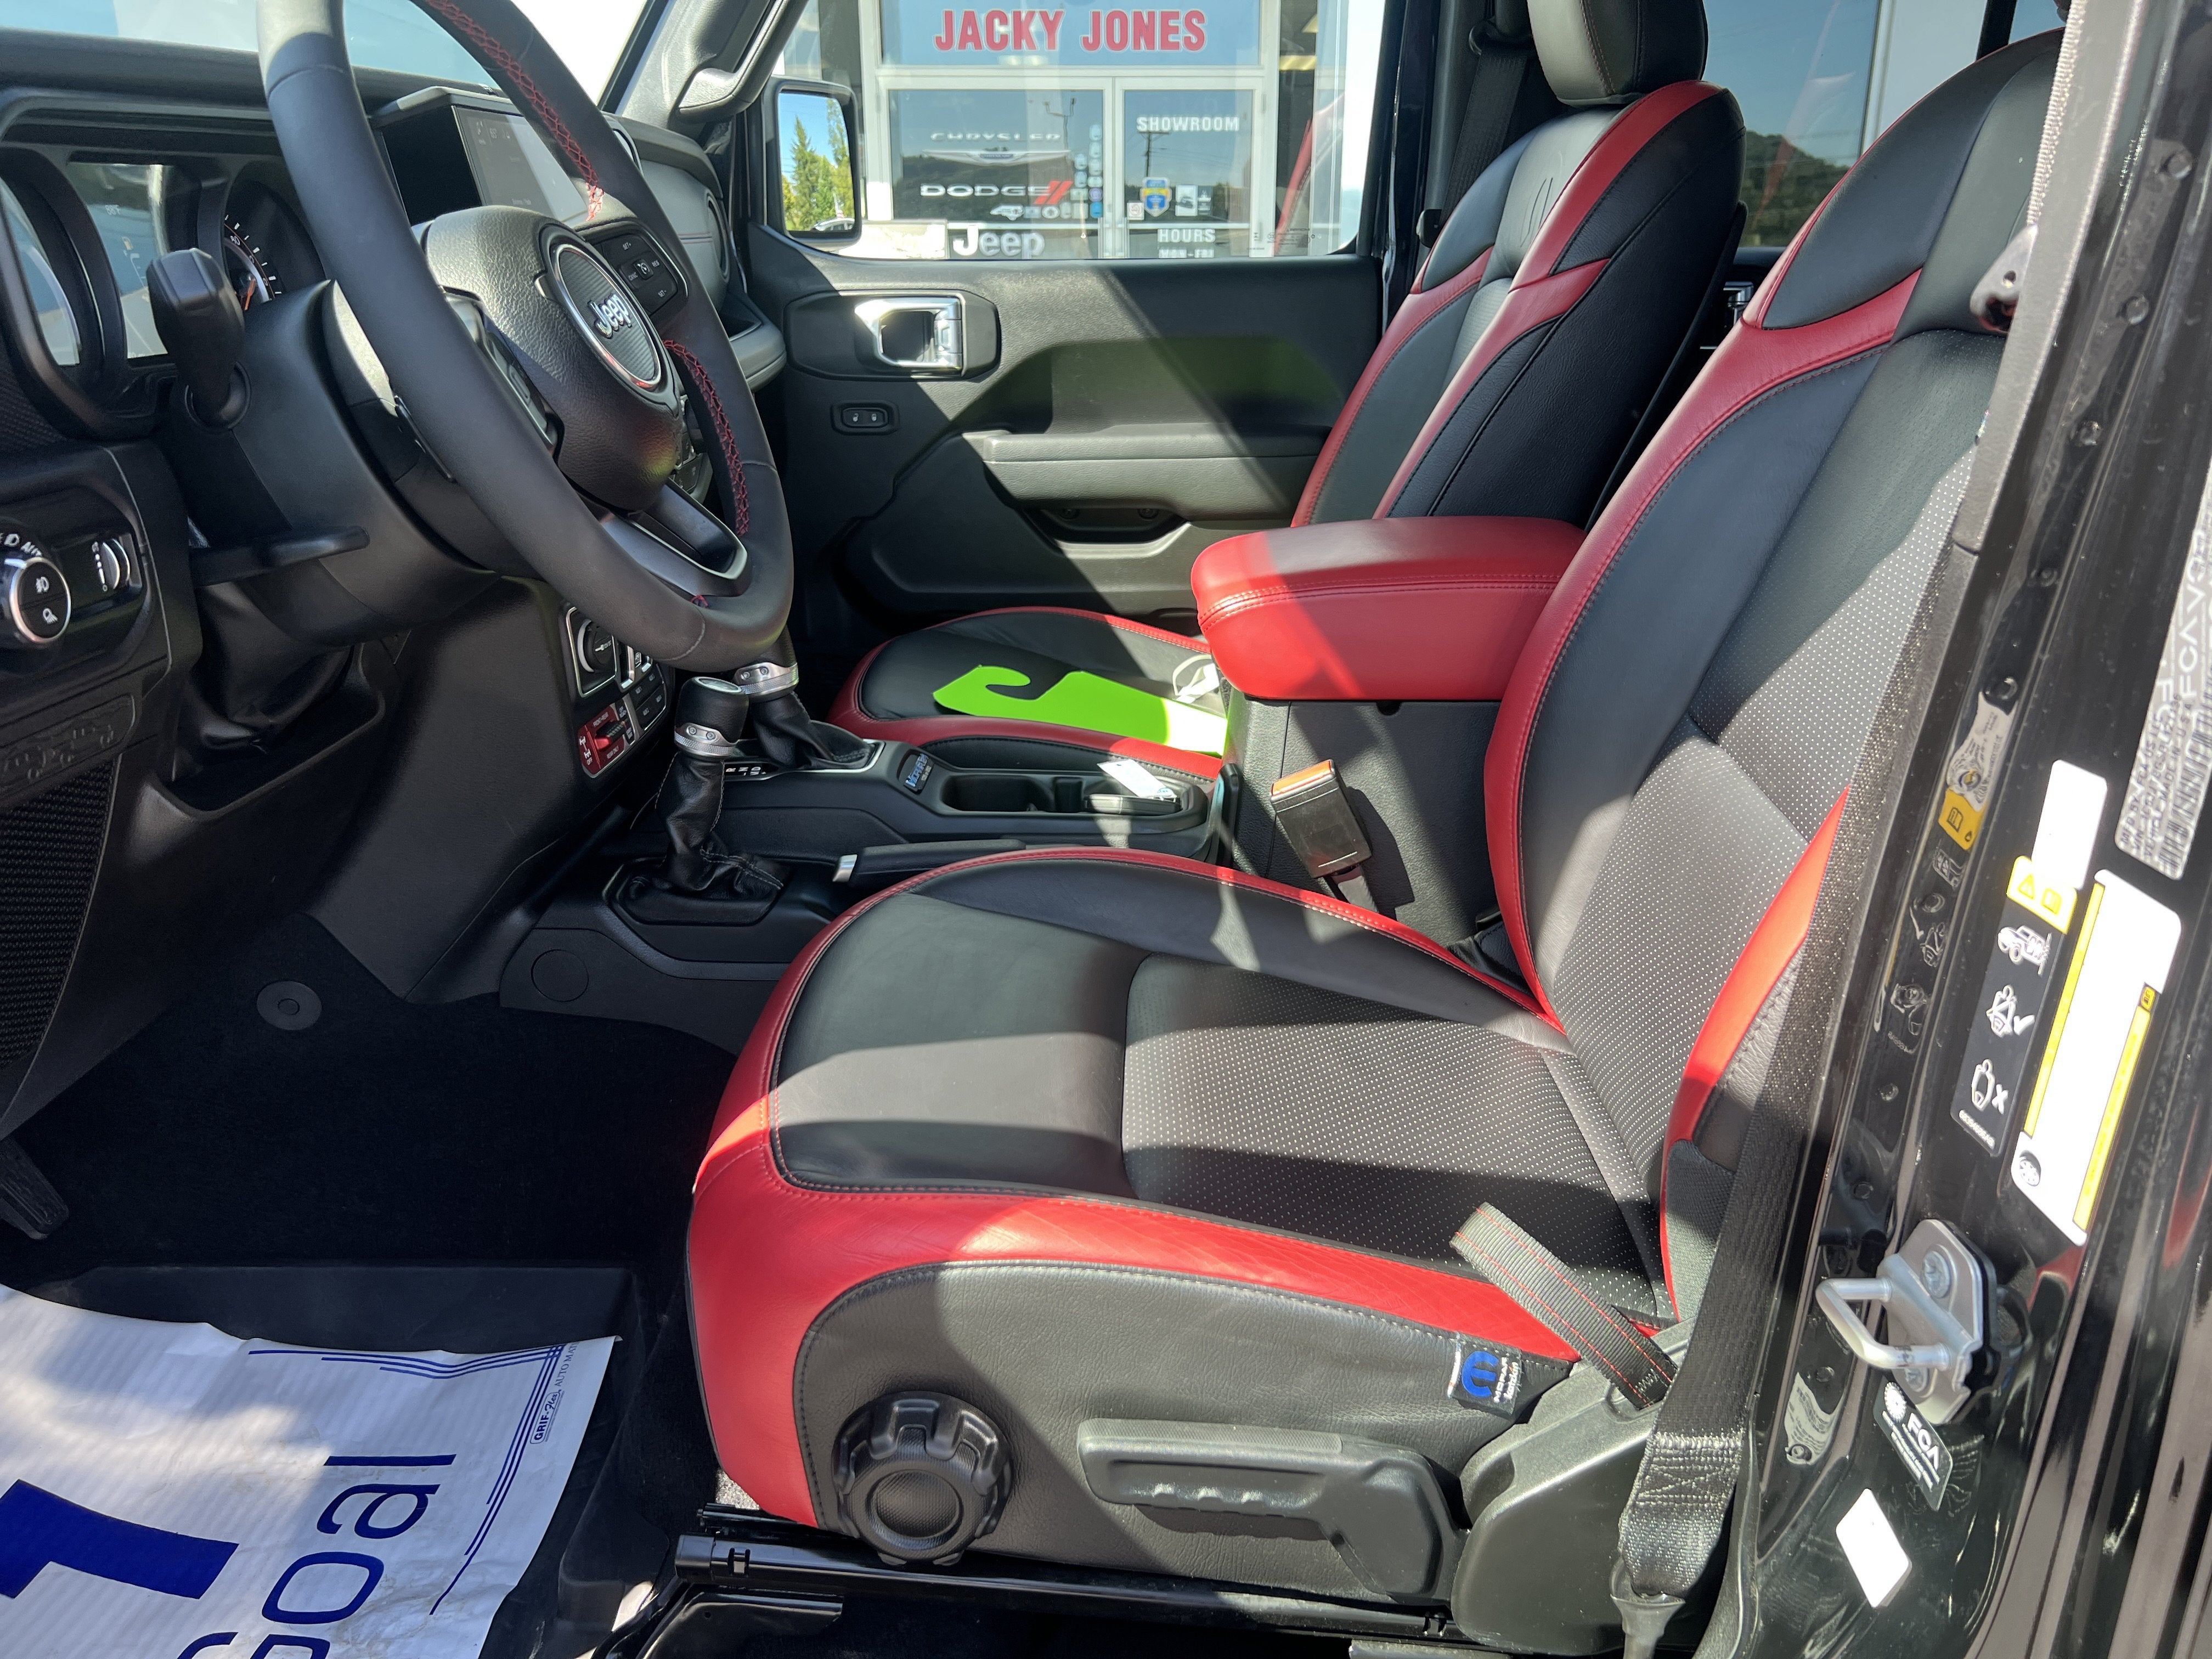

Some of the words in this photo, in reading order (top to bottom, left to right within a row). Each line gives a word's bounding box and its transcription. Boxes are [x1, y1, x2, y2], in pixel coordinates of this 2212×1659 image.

[934, 9, 1064, 51] JACKY
[1081, 9, 1206, 51] JONES
[930, 132, 1061, 141] CHRYSLER
[1136, 117, 1240, 131] SHOWROOM
[920, 183, 1051, 197] DODGE
[953, 223, 1045, 259] Jeep
[1158, 228, 1216, 242] HOURS
[587, 293, 633, 339] Jeep
[1493, 1357, 1509, 1403] MOPAR
[534, 1393, 558, 1441] GRIF-Flex
[554, 1363, 569, 1387] AUTO
[1907, 1412, 1939, 1471] FCA
